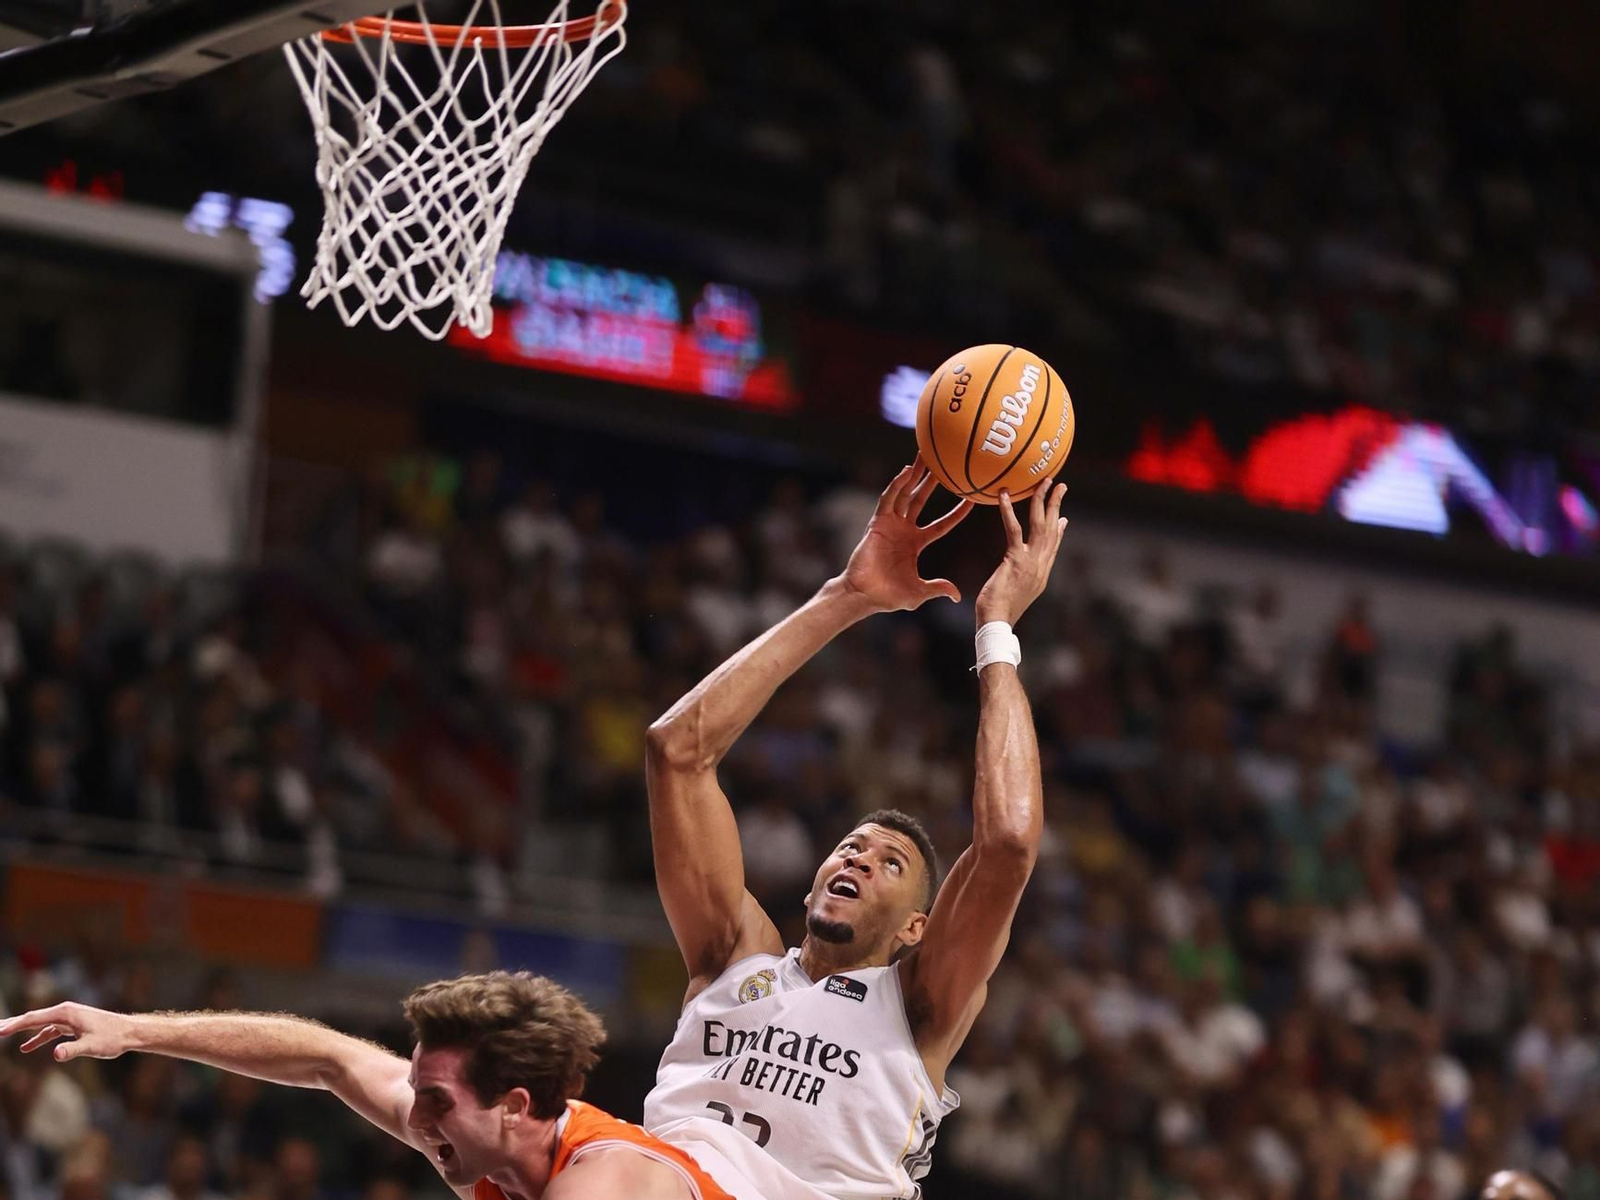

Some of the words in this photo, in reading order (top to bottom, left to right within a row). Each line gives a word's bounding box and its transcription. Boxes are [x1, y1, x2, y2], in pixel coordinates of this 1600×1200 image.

[949, 370, 973, 413] acb
[979, 363, 1042, 457] Wilson
[828, 985, 863, 1000] endesa
[830, 979, 847, 989] liga
[739, 1057, 826, 1107] BETTER
